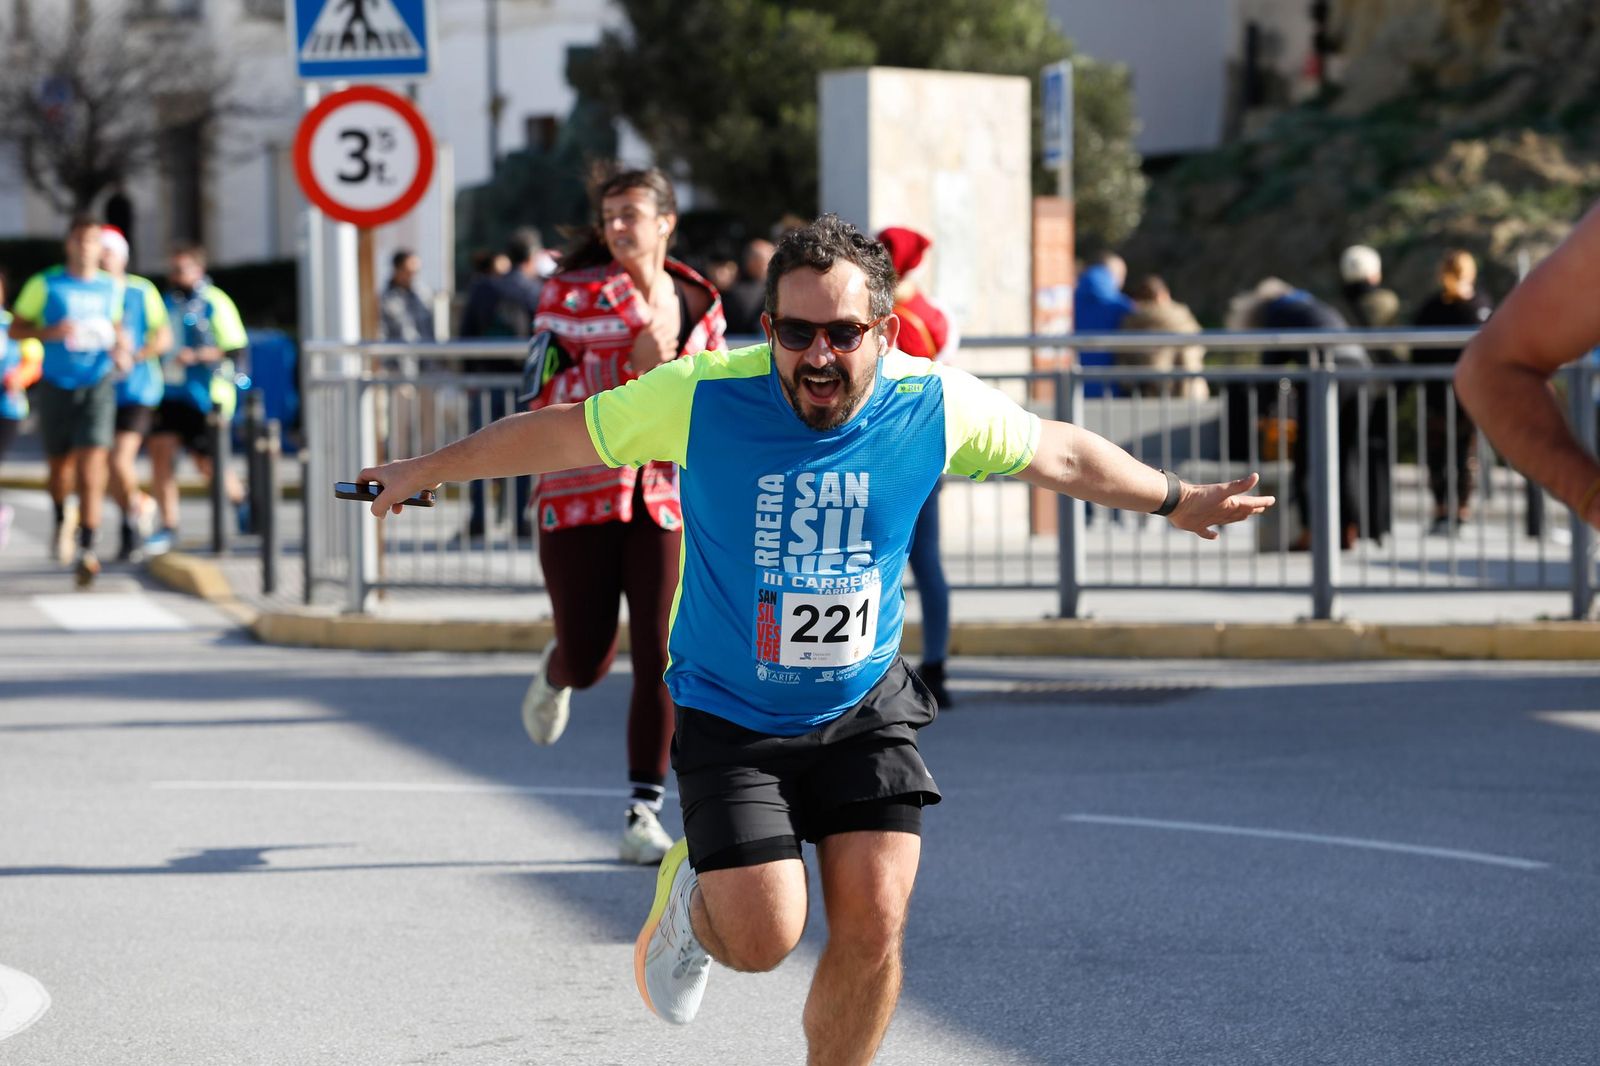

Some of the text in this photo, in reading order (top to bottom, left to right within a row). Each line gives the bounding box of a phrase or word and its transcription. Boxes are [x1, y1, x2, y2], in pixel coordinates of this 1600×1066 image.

[338, 129, 371, 184] 3
[794, 471, 870, 508] SAN
[754, 474, 785, 569] RRERA
[787, 507, 873, 555] SIL
[764, 571, 783, 586] III
[791, 567, 881, 589] CARRERA
[758, 588, 777, 605] SAN
[817, 586, 857, 595] TARIFA
[757, 602, 776, 624] SIL
[790, 598, 870, 643] 221
[756, 622, 781, 642] VES
[756, 640, 781, 663] TRE
[767, 672, 801, 682] TARIFA
